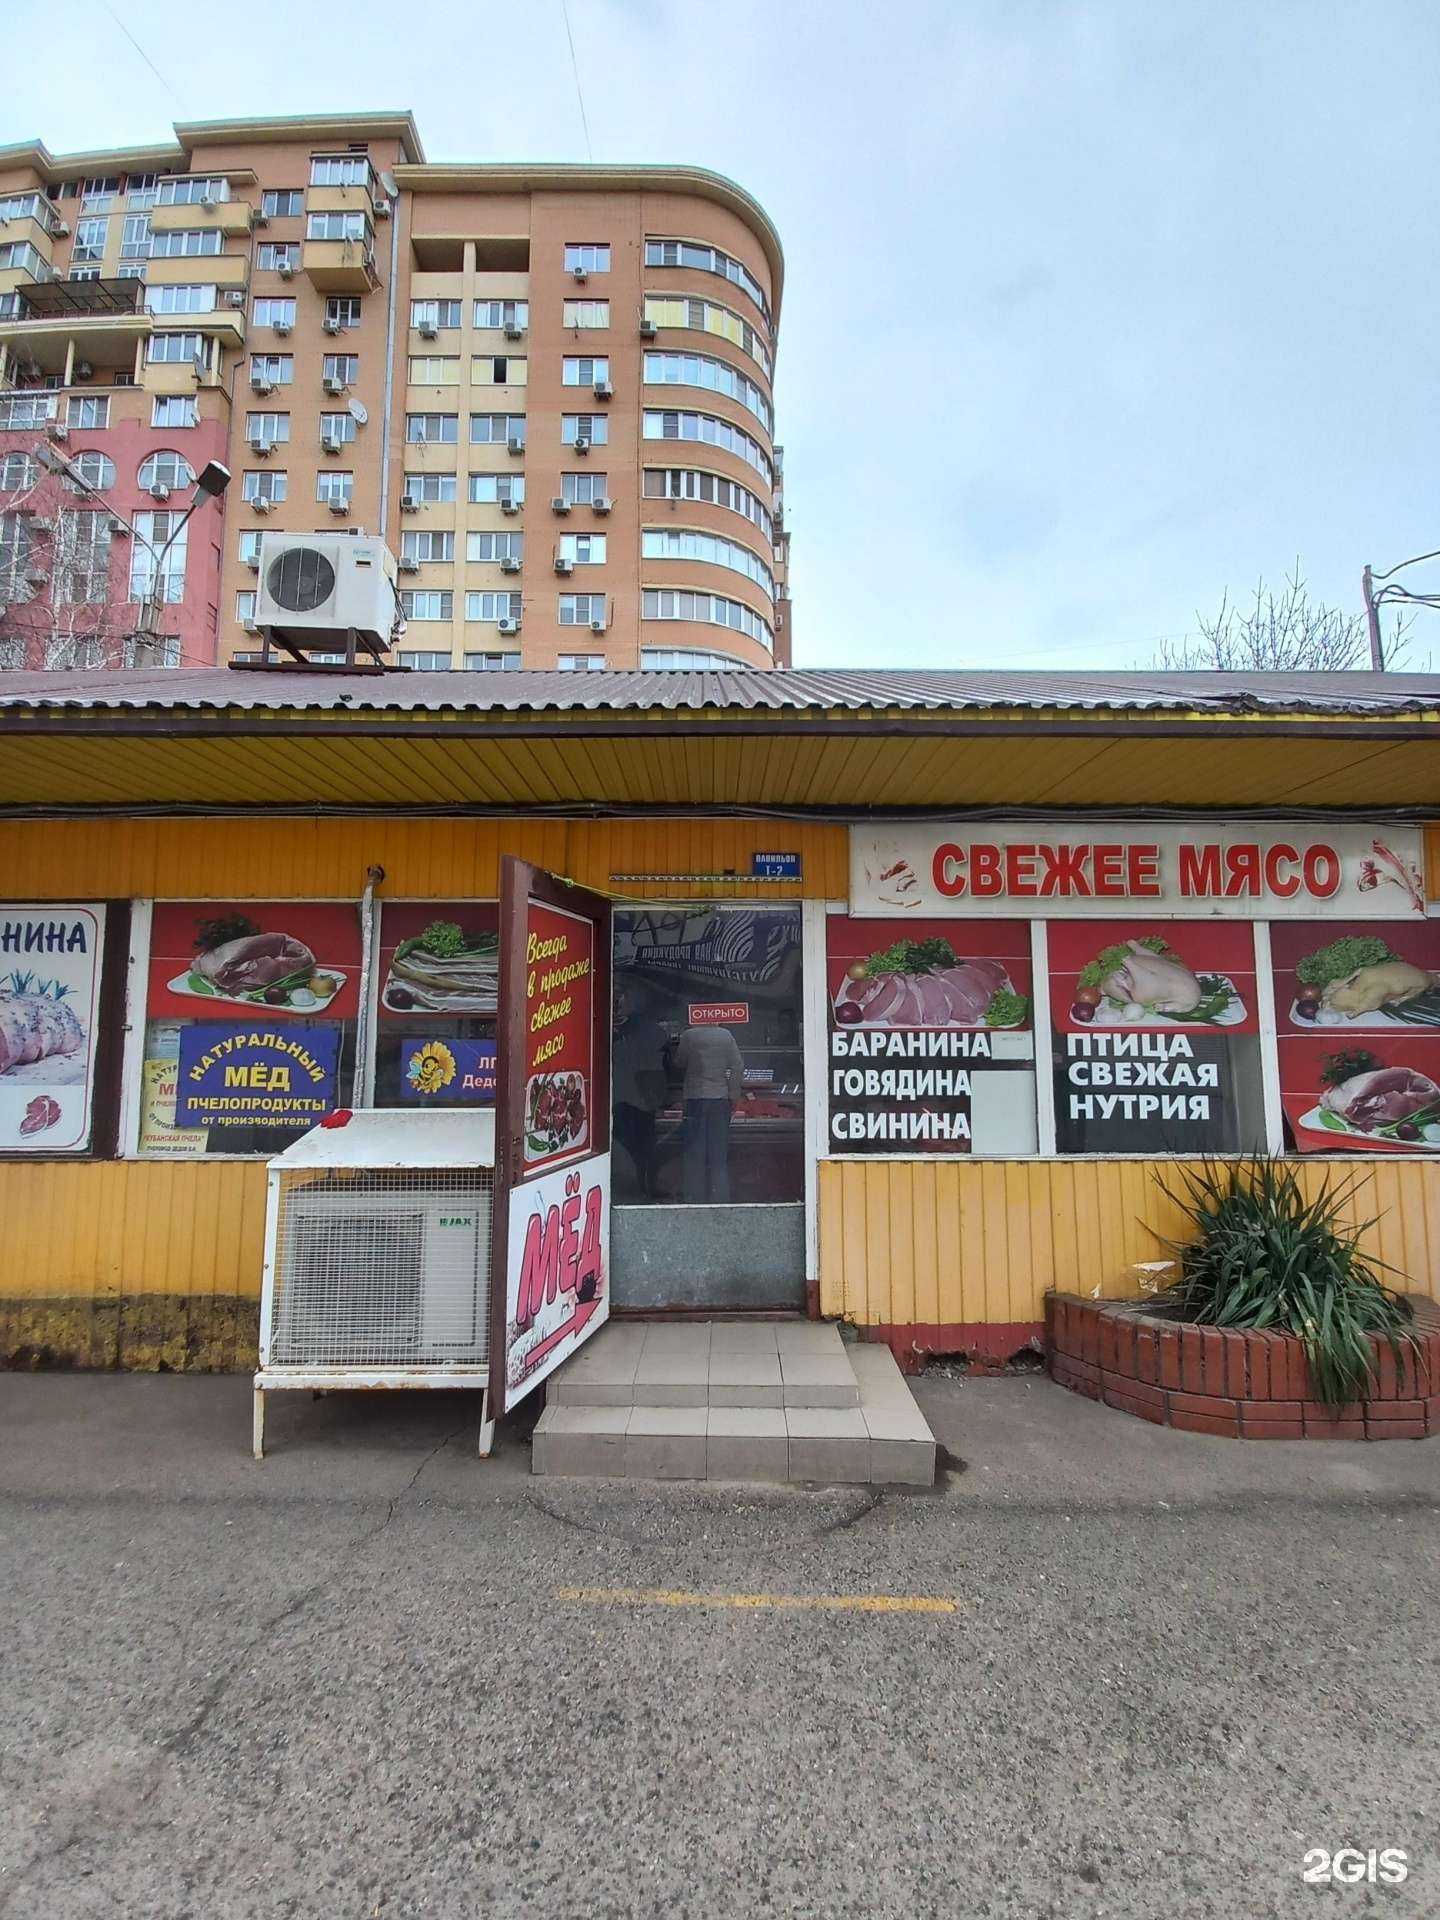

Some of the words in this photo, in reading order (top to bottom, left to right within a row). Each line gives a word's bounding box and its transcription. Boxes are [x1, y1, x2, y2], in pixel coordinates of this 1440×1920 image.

[755, 854, 796, 863] ПАВИЛЬОН
[931, 842, 1161, 898] СВЕЖЕЕ
[1178, 843, 1342, 898] МЯСО
[1, 921, 87, 953] НИНА
[527, 932, 567, 964] Всегда
[527, 970, 536, 998] в
[540, 957, 591, 999] продаже
[530, 996, 572, 1032] свежее
[692, 1008, 745, 1019] ОТКРЫТО
[189, 1033, 327, 1083] НАТУРАЛЬНЫЙ
[532, 1032, 565, 1067] мясо
[832, 1032, 991, 1057] БАРАНИНА
[1067, 1033, 1194, 1061] ПТИЦА
[224, 1062, 291, 1092] МЁД
[833, 1069, 972, 1100] ГОВЯДИНА
[1068, 1062, 1219, 1087] СВЕЖАЯ
[187, 1097, 326, 1112] ПЧЕЛОПРОДУКТЫ
[1069, 1095, 1210, 1120] НУТРИЯ
[201, 1116, 214, 1126] от
[217, 1115, 311, 1127] производителя
[831, 1113, 971, 1139] СВИНИНА
[516, 1170, 602, 1324] МЁД
